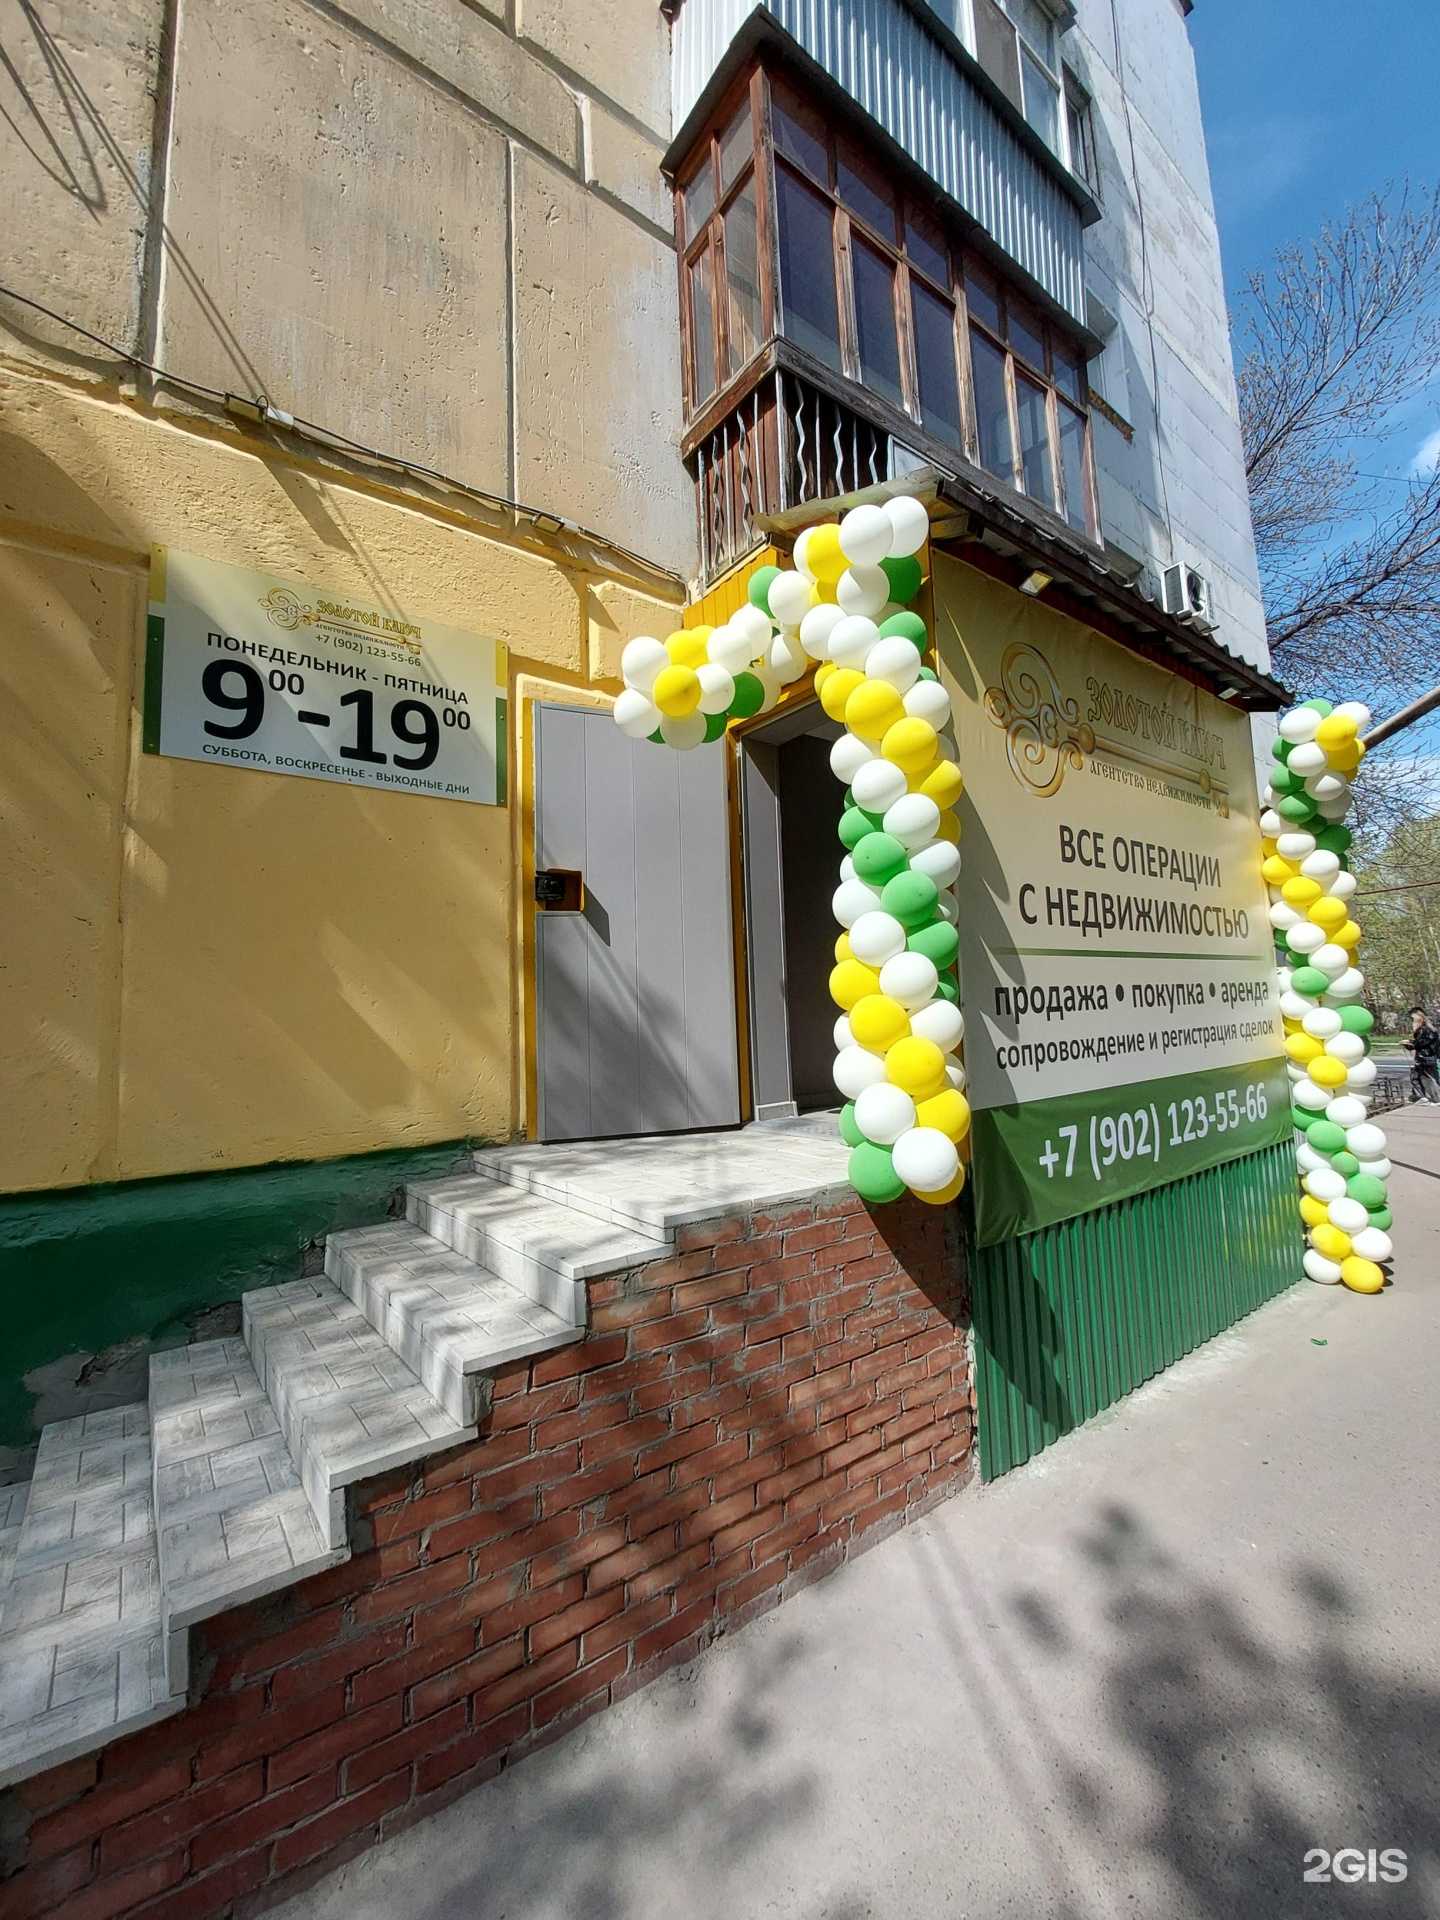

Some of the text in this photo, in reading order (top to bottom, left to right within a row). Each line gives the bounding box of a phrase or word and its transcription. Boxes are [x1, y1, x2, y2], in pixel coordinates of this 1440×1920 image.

[317, 600, 380, 628] ЗОЛОТОЙ
[207, 632, 366, 681] ПОНЕДЕЛЬНИК
[384, 673, 469, 705] ПЯТНИЦА
[316, 635, 421, 667] +7 (902) 123-55-66
[1087, 676, 1176, 750] ЗОЛОТОЙ
[202, 744, 272, 765] СУББОТА,
[275, 755, 365, 779] ВОСКРЕСЕНЬЕ
[376, 772, 443, 792] ВЫХОДНЫЕ
[445, 782, 470, 795] ДНИ
[1059, 824, 1222, 891] ВСЕ ОПЕРАЦИИ
[1018, 883, 1249, 940] С НЕДВИЖИМОСТЬЮ
[994, 979, 1269, 1025] продажа покупка аренда
[996, 1018, 1274, 1072] сопровождение и регистрация сделок
[1039, 1082, 1268, 1181] +7 (902) 123-55-66
